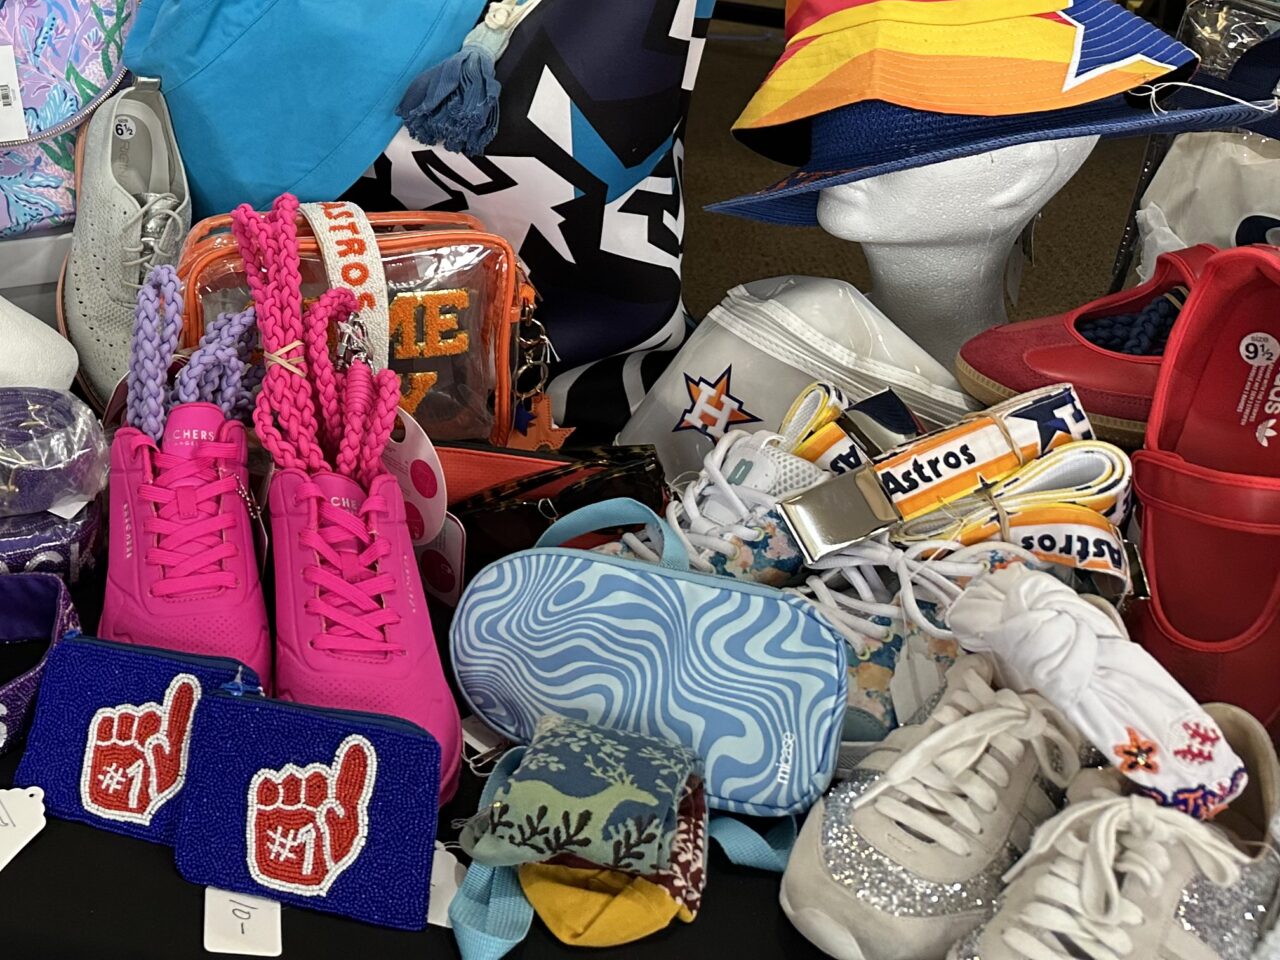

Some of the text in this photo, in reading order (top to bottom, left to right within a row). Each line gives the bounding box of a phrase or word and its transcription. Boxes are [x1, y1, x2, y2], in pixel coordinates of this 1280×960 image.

[172, 429, 216, 442] CHERS
[880, 443, 976, 496] Astros
[1022, 532, 1123, 570] Astros
[775, 731, 795, 785] micase
[96, 760, 145, 809] #1
[266, 823, 317, 876] #1
